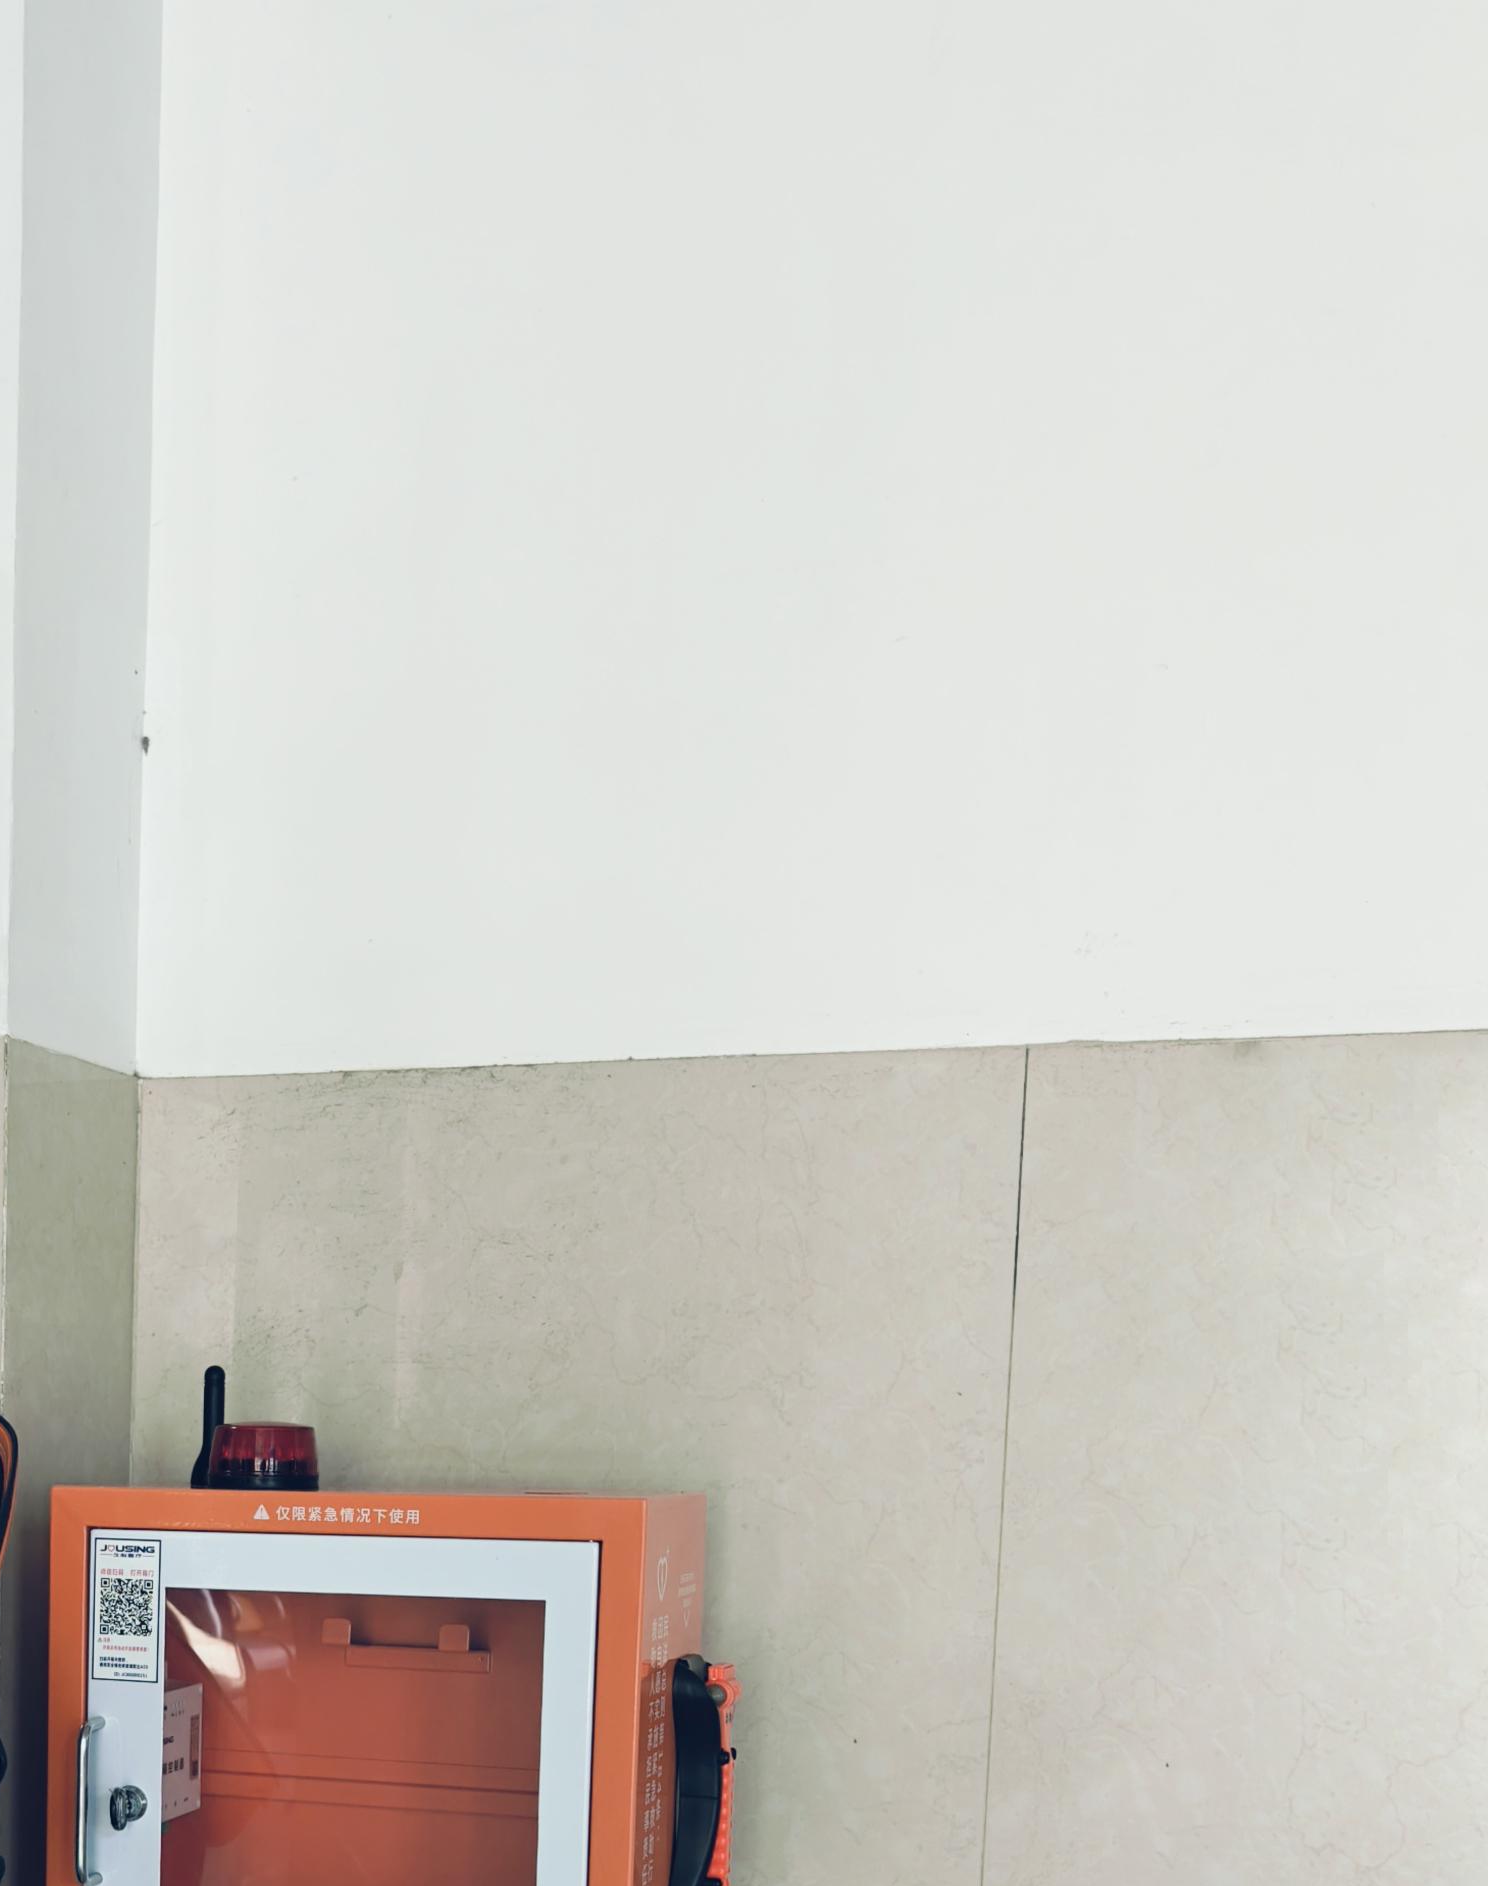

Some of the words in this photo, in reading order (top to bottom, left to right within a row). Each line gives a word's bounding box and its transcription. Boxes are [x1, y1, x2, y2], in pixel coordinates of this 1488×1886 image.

[275, 1505, 421, 1525] 仅限紧急情况下使用
